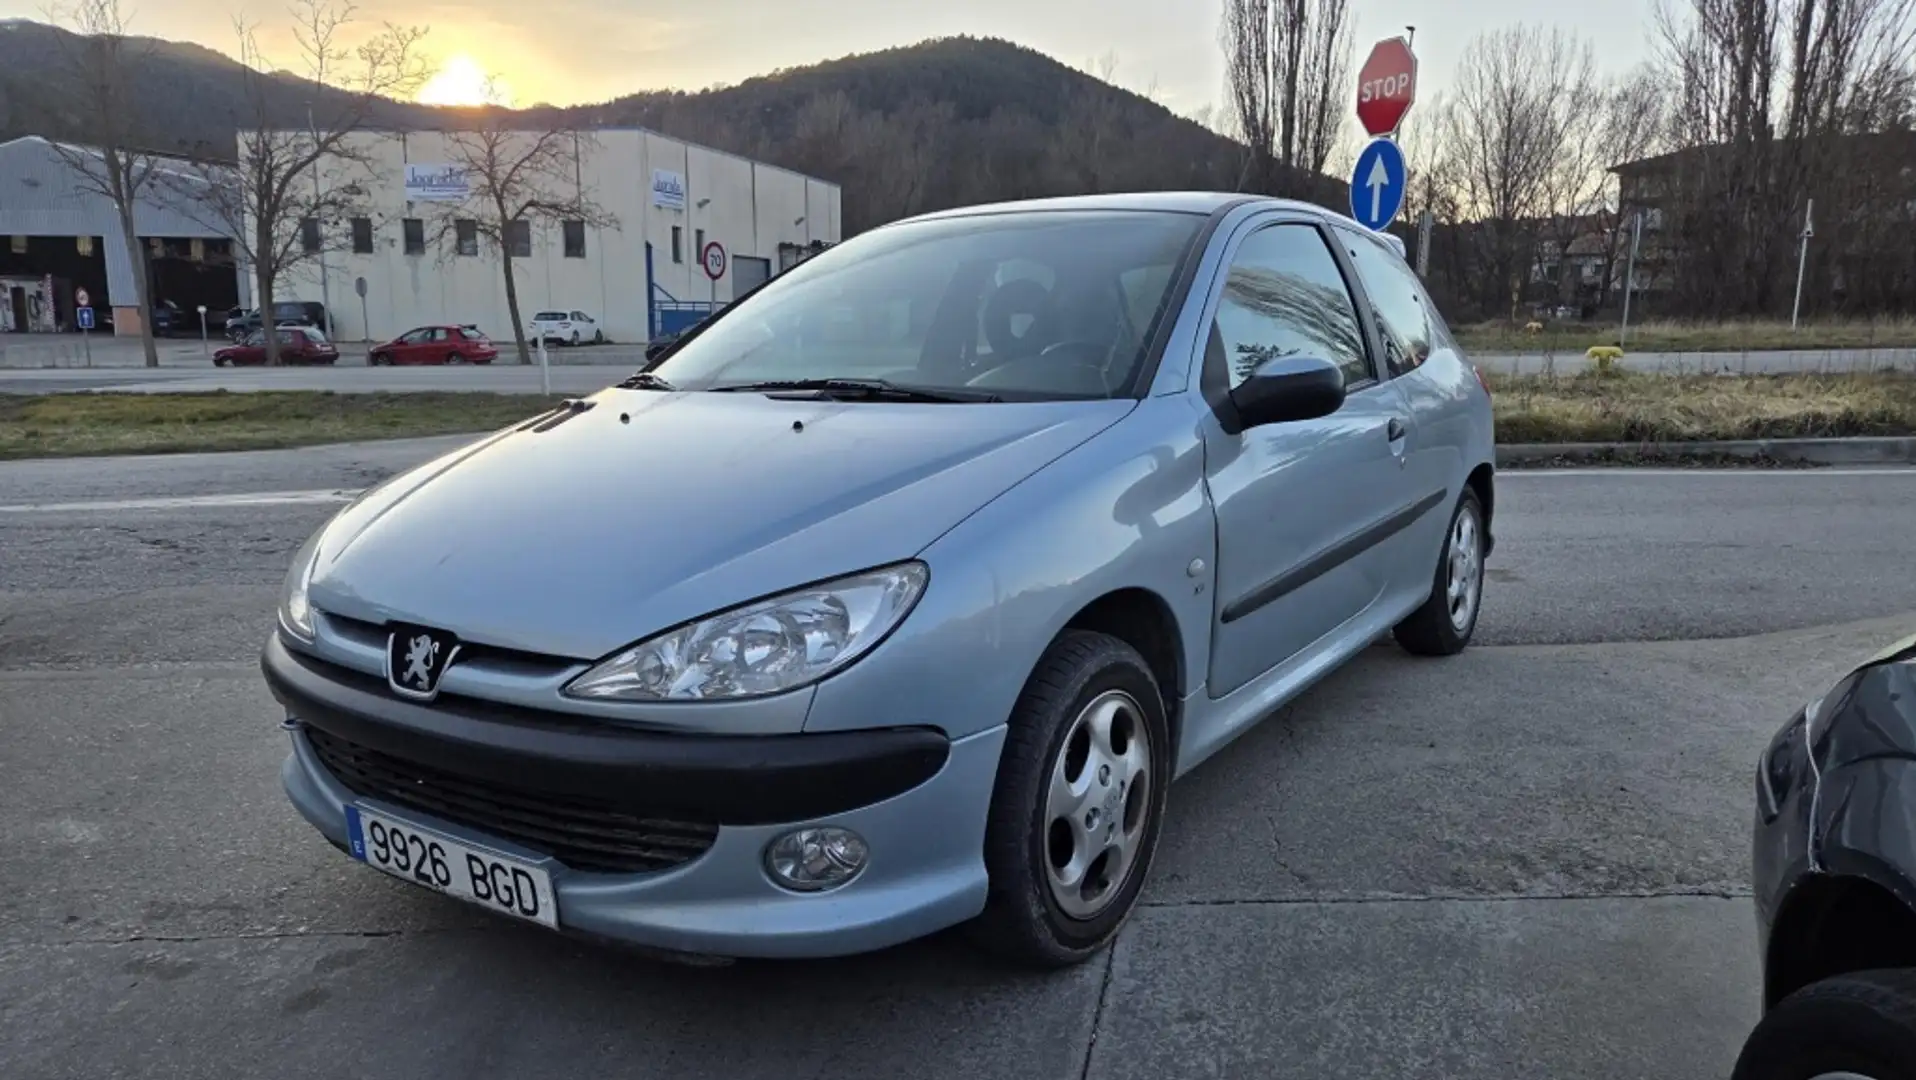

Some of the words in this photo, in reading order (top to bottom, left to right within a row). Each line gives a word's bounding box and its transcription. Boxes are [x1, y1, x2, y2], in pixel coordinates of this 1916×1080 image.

[1361, 73, 1409, 102] STOP
[710, 254, 721, 267] 70
[369, 820, 451, 886] 9926
[466, 853, 539, 916] BGD
